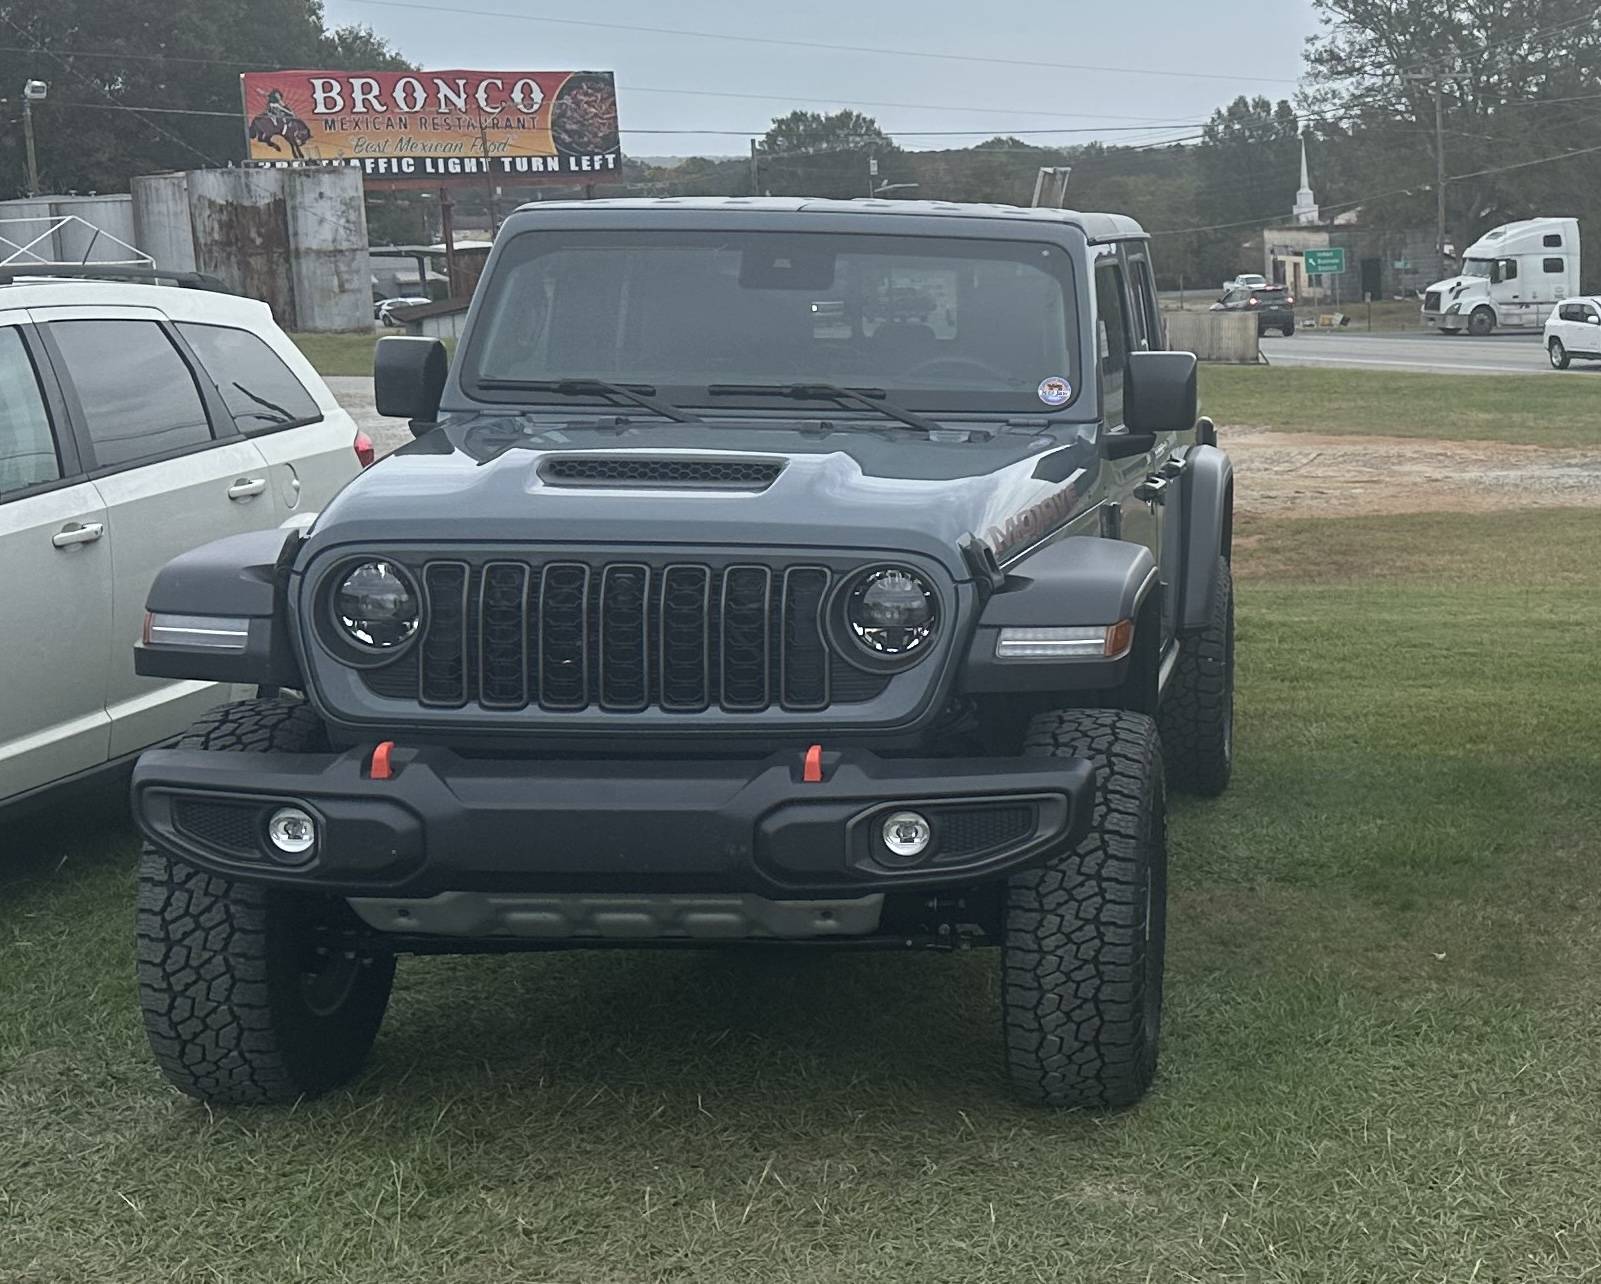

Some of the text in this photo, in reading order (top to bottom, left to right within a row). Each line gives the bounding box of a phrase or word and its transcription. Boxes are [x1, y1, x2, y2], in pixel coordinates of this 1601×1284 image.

[309, 77, 544, 114] BRONCO
[324, 116, 539, 131] MEXICAN RESTAURANT
[394, 136, 464, 153] Mexican
[470, 135, 511, 153] Food
[425, 157, 491, 174] LIGHT
[501, 156, 560, 173] TURN
[569, 153, 616, 172] LEFT
